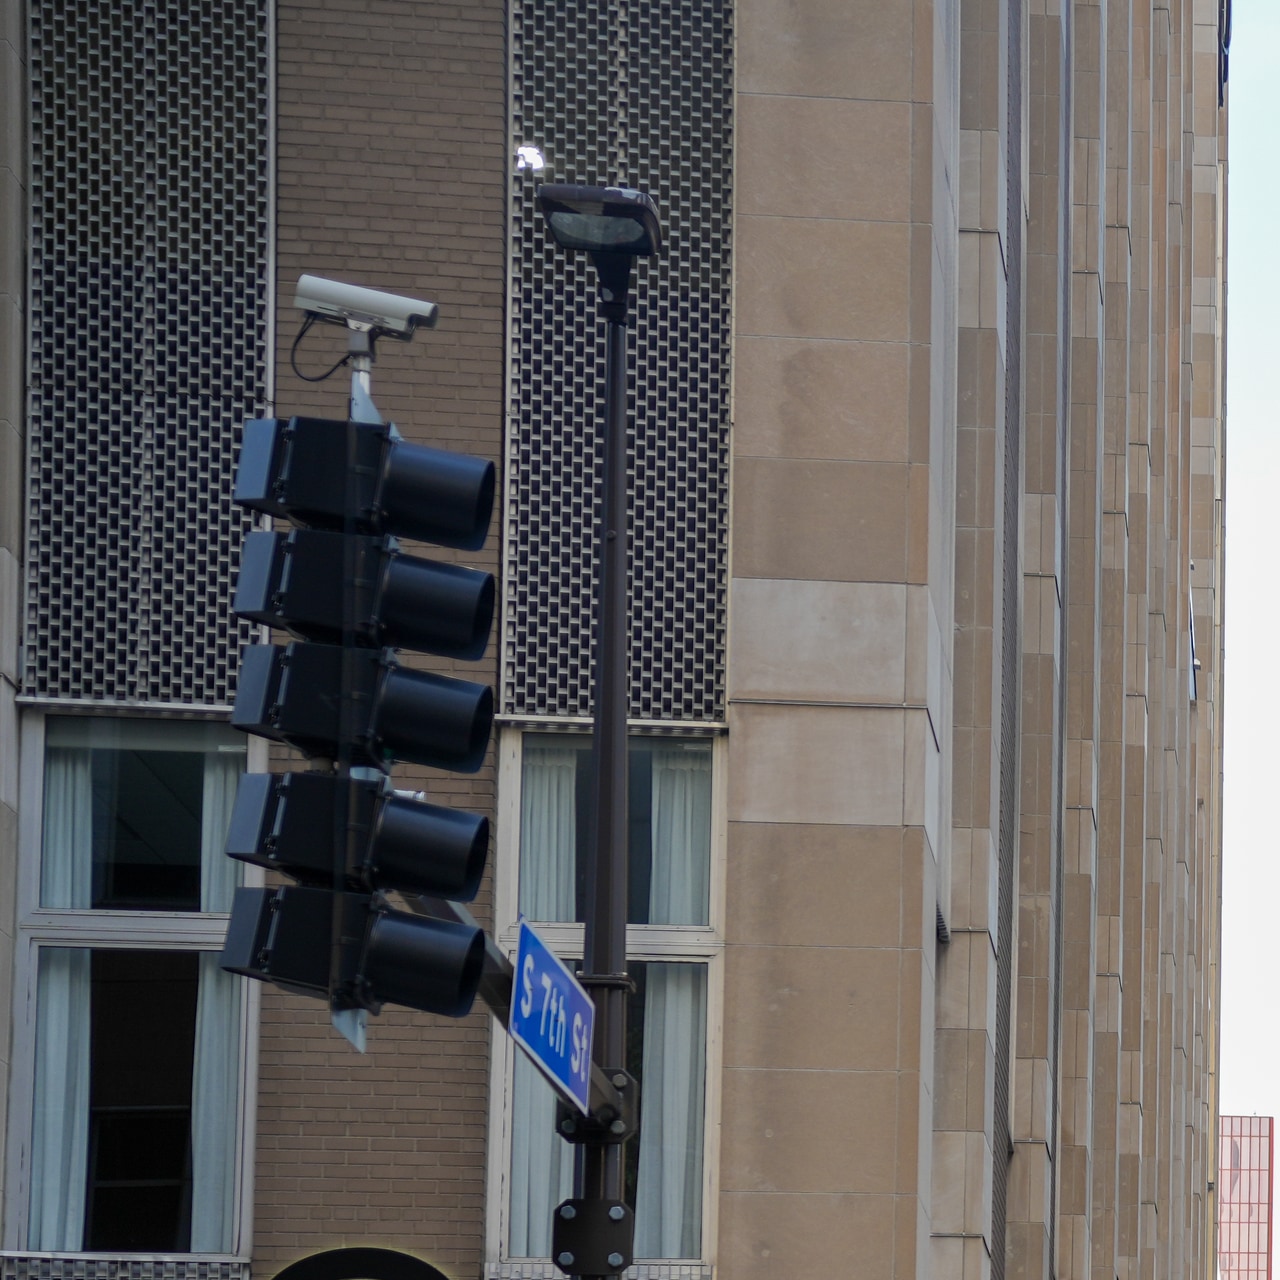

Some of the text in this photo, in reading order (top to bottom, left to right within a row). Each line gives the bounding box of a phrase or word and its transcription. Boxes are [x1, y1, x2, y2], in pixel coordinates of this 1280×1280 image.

[519, 953, 588, 1083] S 7th St
